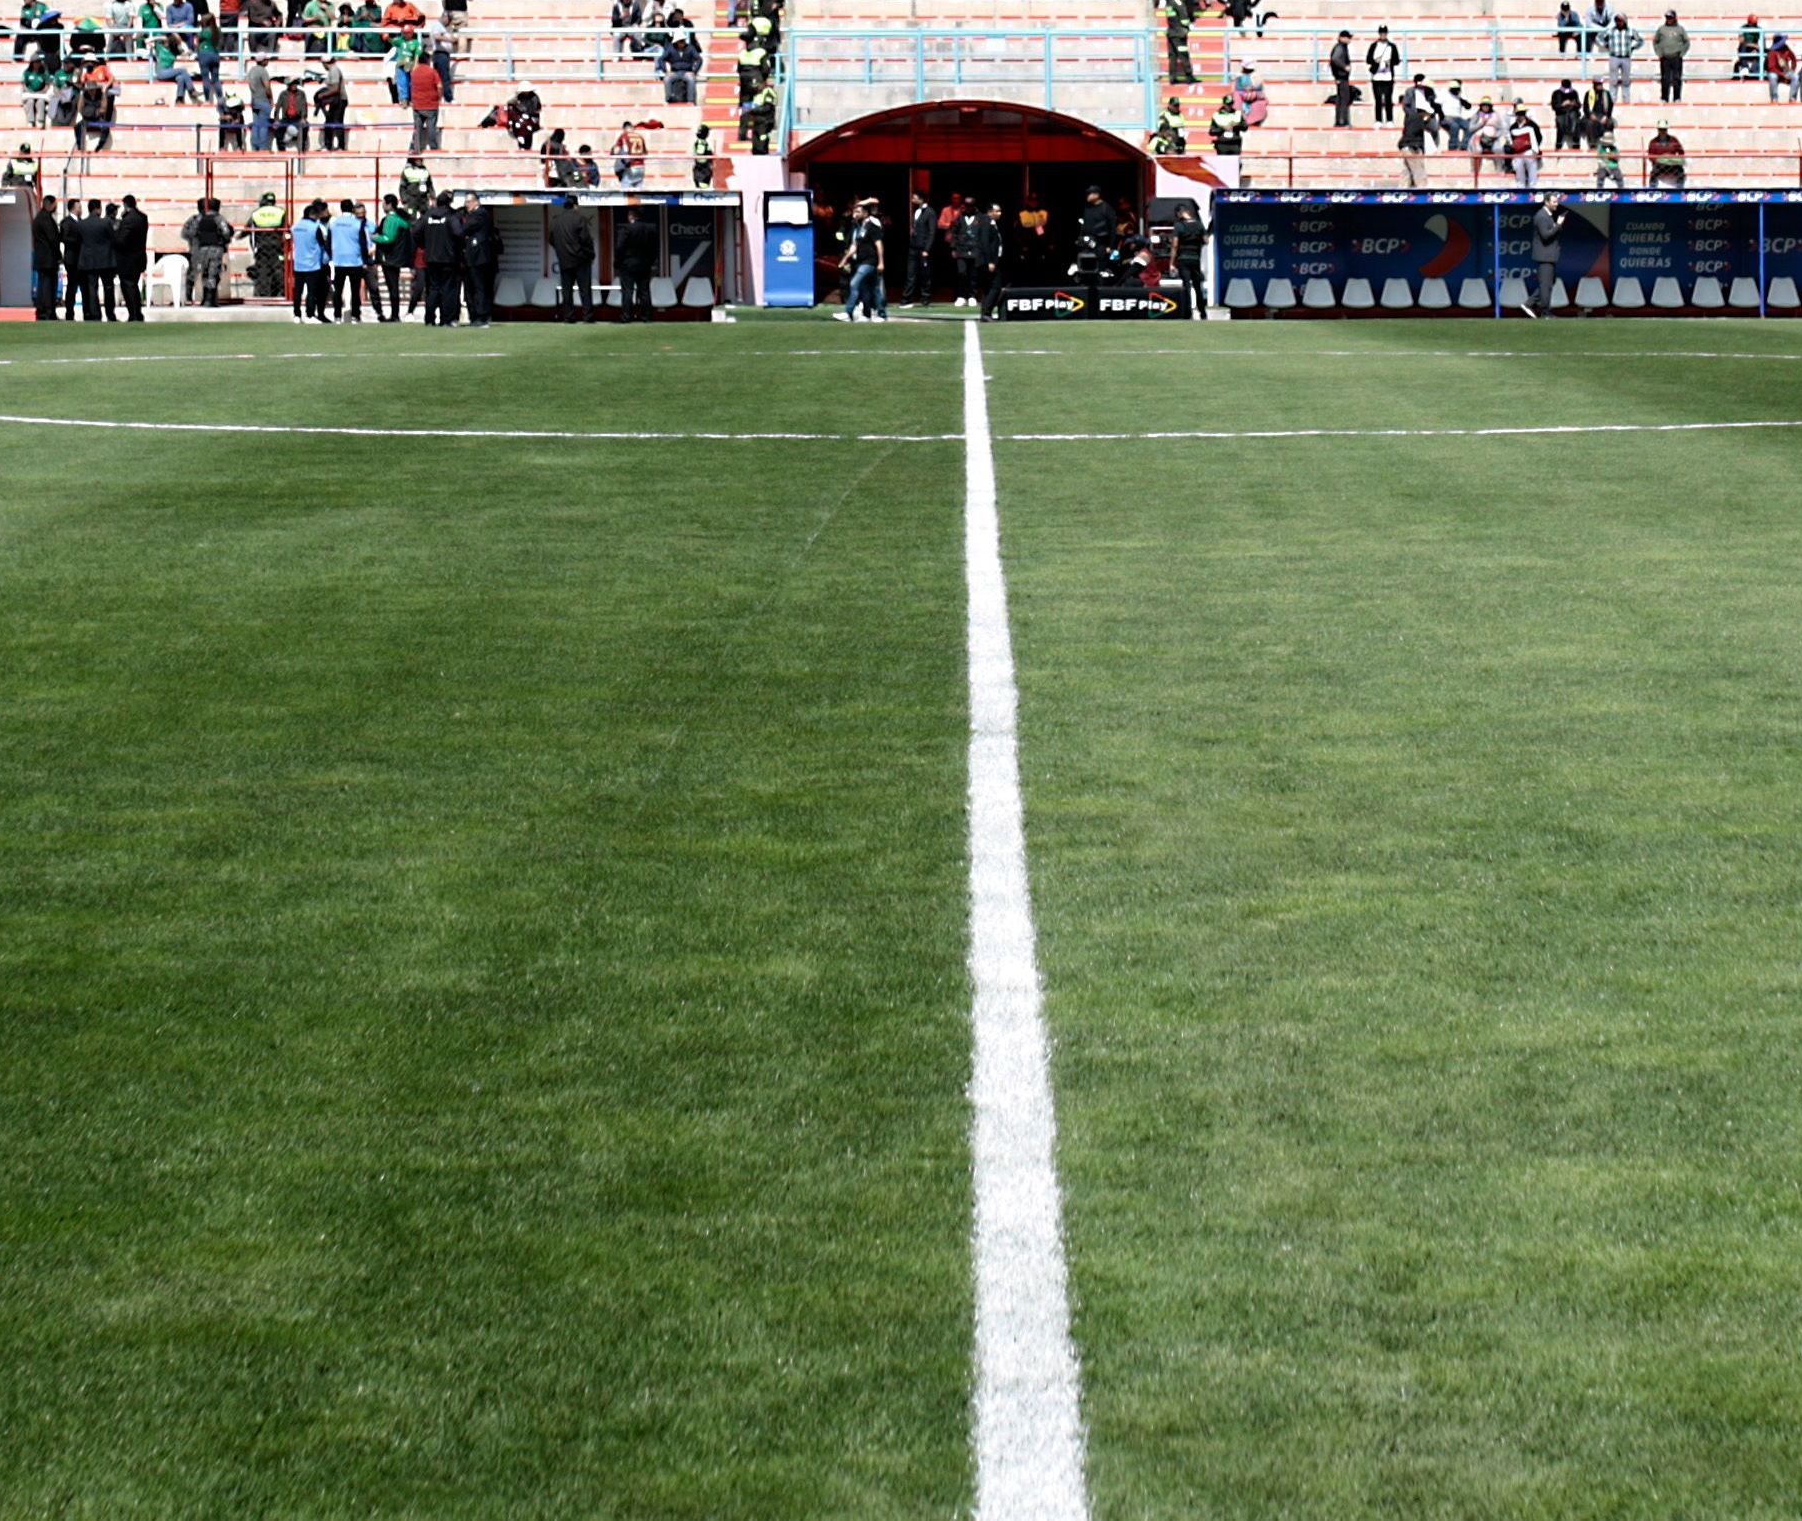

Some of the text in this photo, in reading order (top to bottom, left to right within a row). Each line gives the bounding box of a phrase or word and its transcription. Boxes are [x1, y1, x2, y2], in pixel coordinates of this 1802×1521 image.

[670, 222, 711, 236] Check
[1300, 221, 1327, 233] BCP
[1695, 219, 1723, 231] BCP
[1223, 234, 1275, 245] QUIERAS
[1620, 233, 1671, 244] QUIERAS
[1299, 241, 1327, 254] BCP
[1362, 238, 1399, 254] BCP
[1629, 247, 1662, 256] DONDE
[1695, 240, 1723, 252] BCP
[1232, 248, 1265, 258] DONDE
[1223, 259, 1275, 270] QUIERAS
[1299, 263, 1327, 275] BCP
[1620, 257, 1672, 269] QUIERAS
[1695, 261, 1723, 273] BCP
[1007, 298, 1075, 311] FBF Play
[1099, 298, 1168, 312] FBF Play
